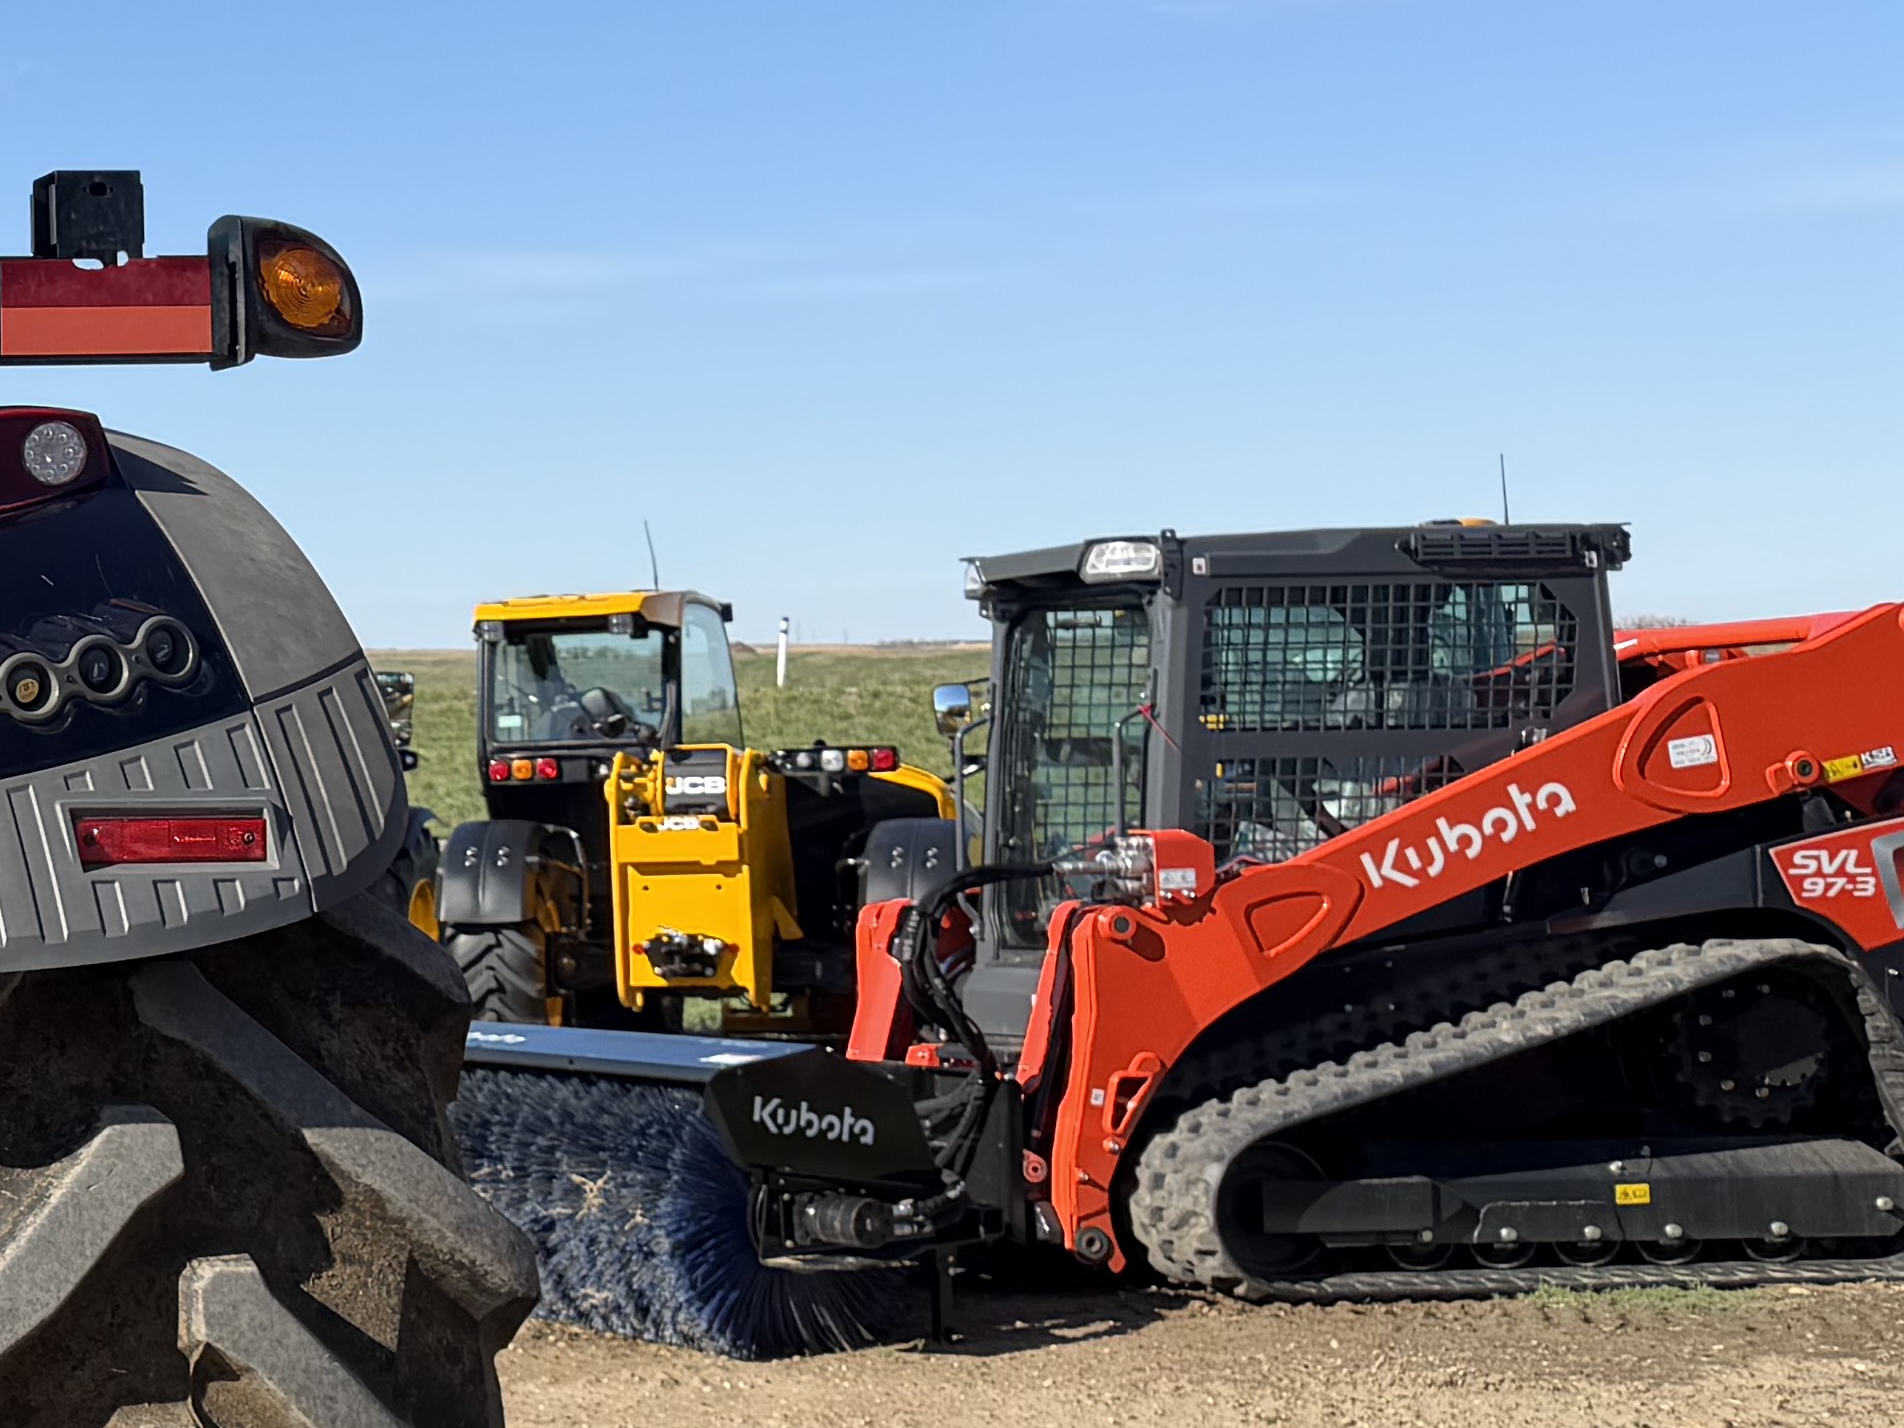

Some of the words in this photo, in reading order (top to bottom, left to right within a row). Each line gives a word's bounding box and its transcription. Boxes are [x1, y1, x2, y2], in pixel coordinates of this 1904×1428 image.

[665, 776, 726, 795] JCB
[1360, 782, 1577, 889] Kubota
[1787, 849, 1872, 874] SVL
[1800, 876, 1876, 897] 97-3
[753, 1095, 875, 1145] Kubota
